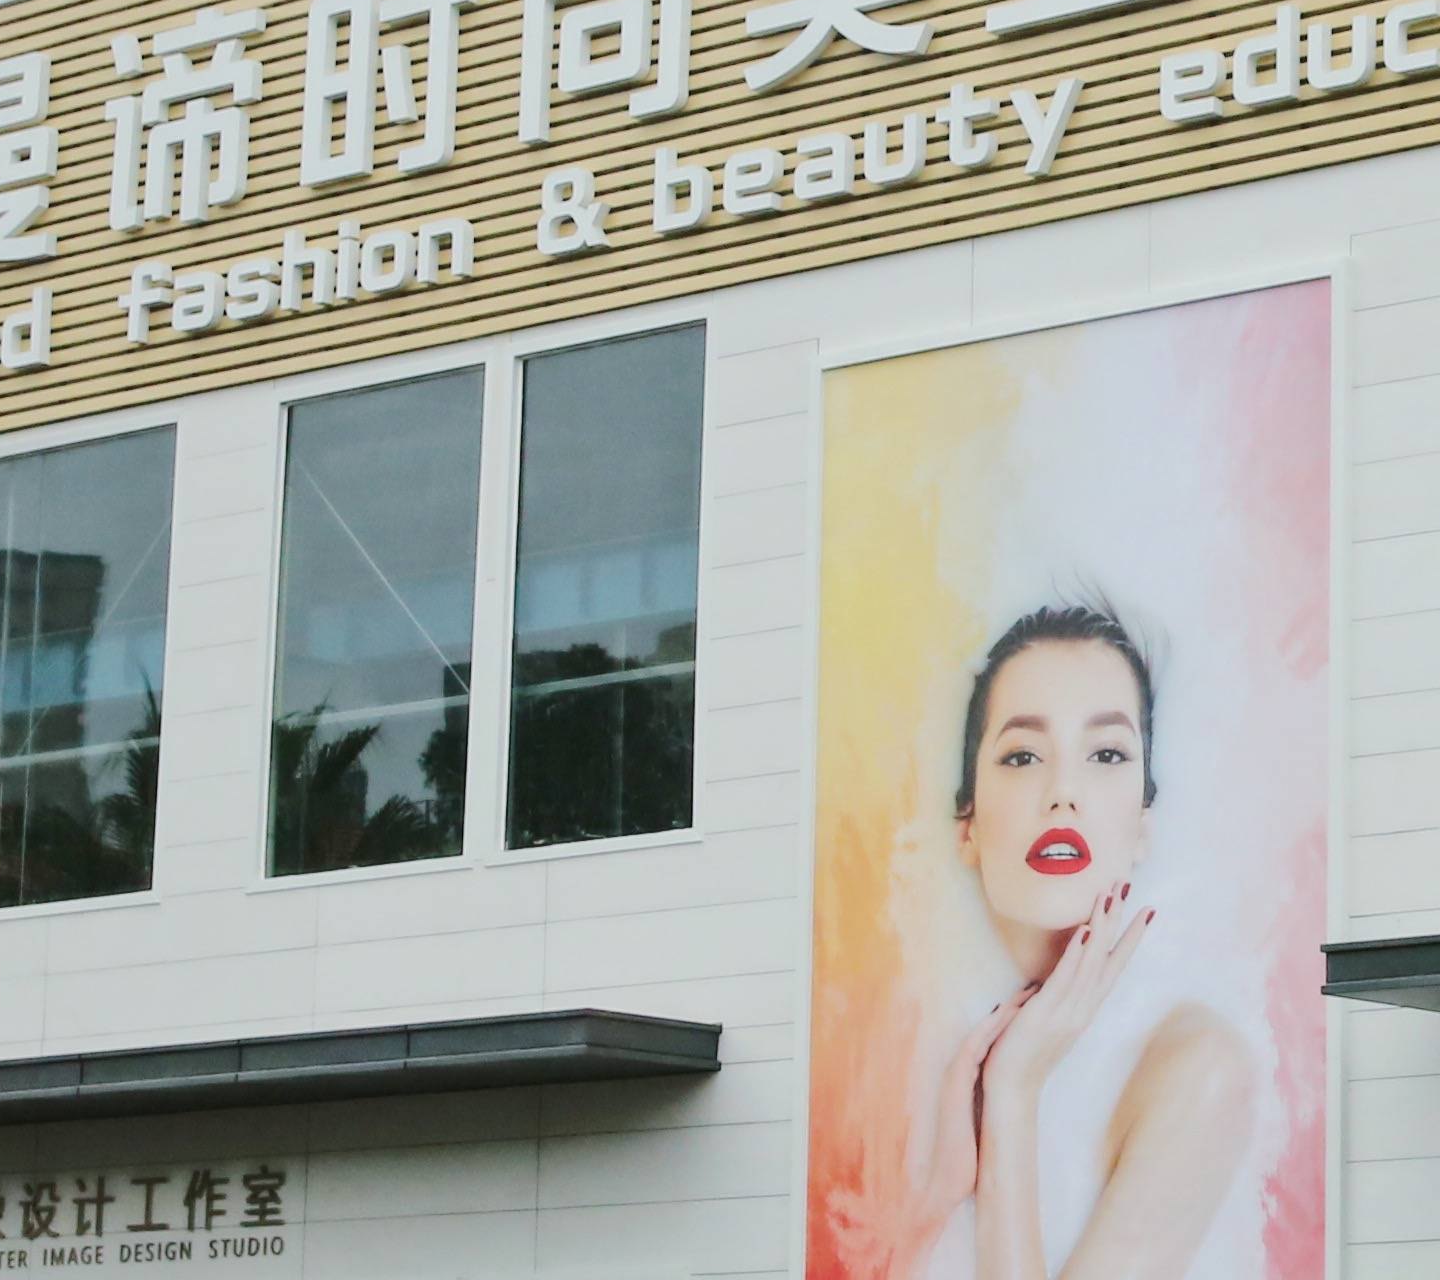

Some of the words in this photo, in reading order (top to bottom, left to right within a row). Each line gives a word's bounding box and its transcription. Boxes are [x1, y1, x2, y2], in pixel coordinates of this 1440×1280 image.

[118, 216, 474, 345] fashion
[536, 166, 613, 258] &
[651, 75, 1087, 236] beauty
[42, 1245, 105, 1267] IMAGE
[118, 1241, 193, 1264] DESIGN
[208, 1235, 286, 1260] STUDIO
